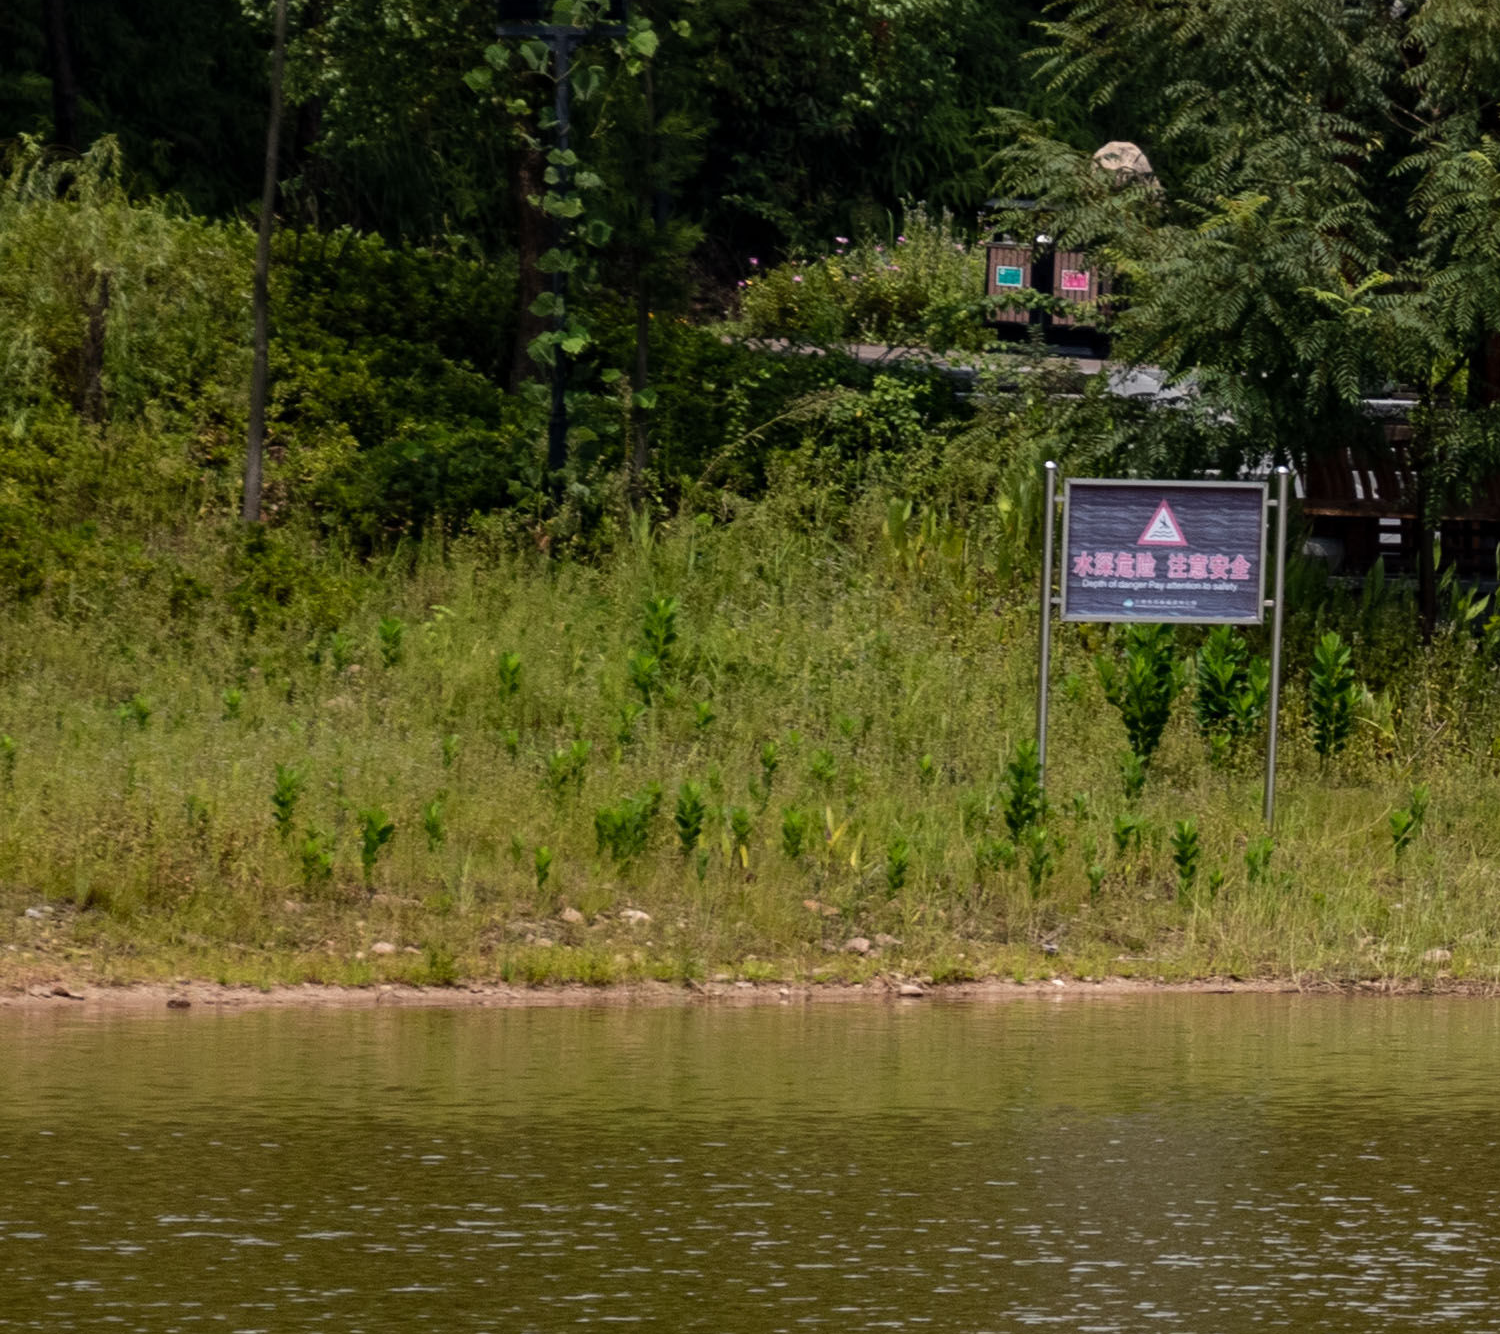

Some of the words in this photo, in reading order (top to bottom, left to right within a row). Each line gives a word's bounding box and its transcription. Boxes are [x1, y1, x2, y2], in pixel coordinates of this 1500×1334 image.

[1073, 551, 1157, 578] 水深危险
[1167, 553, 1251, 579] 注意安全
[1082, 579, 1107, 588] Depth
[1108, 579, 1117, 588] of
[1118, 580, 1147, 590] danger
[1148, 580, 1165, 591] Pay
[1212, 582, 1238, 592] safety
